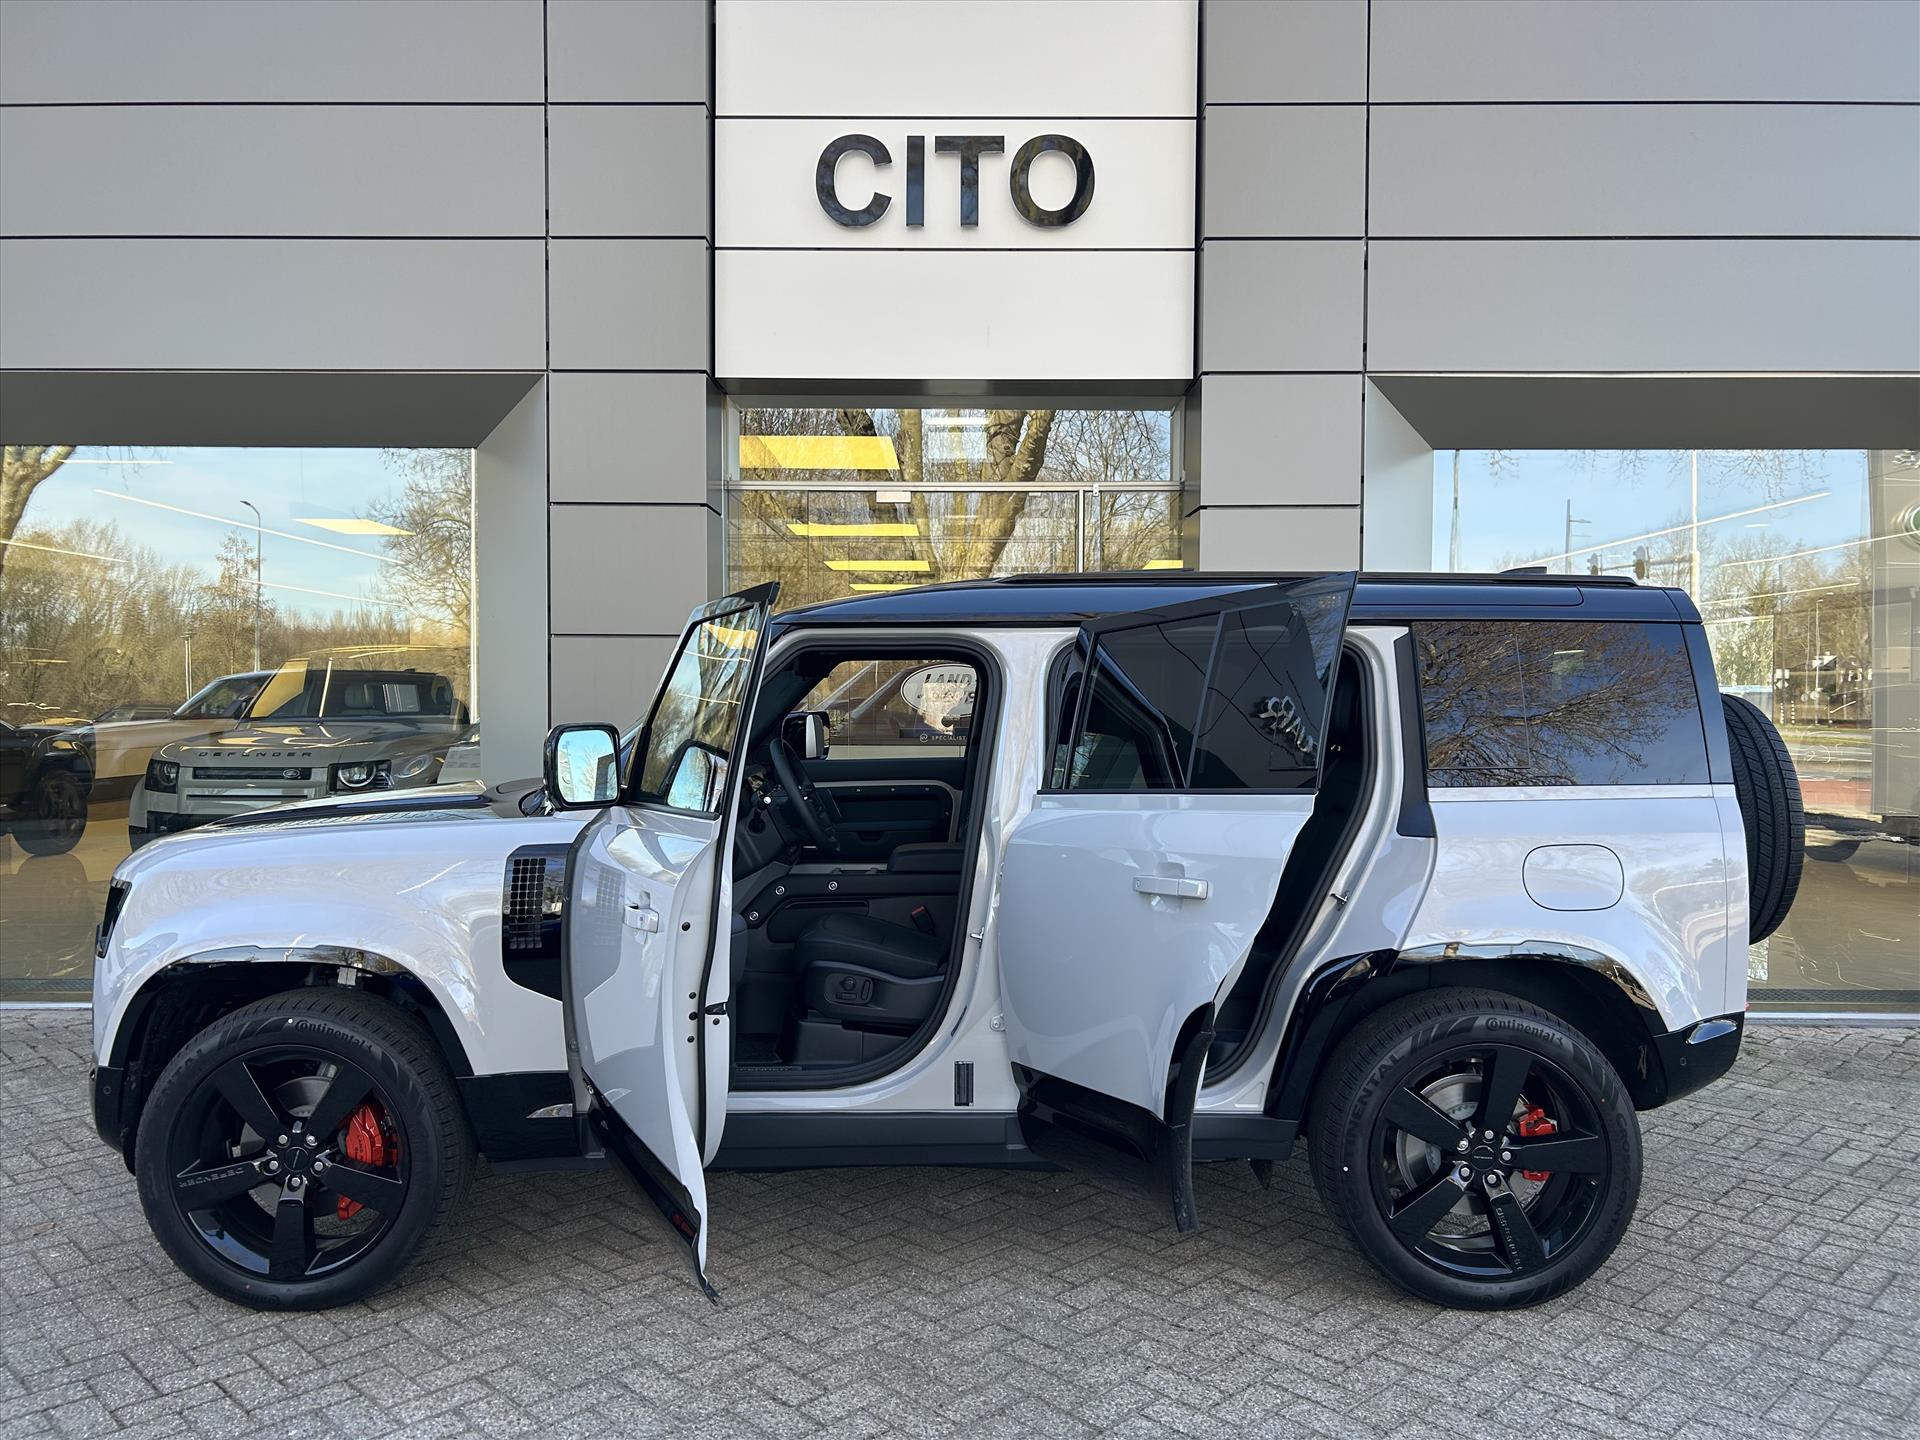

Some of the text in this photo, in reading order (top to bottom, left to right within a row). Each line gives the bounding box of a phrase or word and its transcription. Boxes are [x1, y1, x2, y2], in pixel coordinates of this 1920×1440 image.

[815, 133, 1096, 228] CITO
[925, 673, 973, 687] LAND
[295, 1019, 367, 1048] Continental
[1485, 1017, 1556, 1043] Continental
